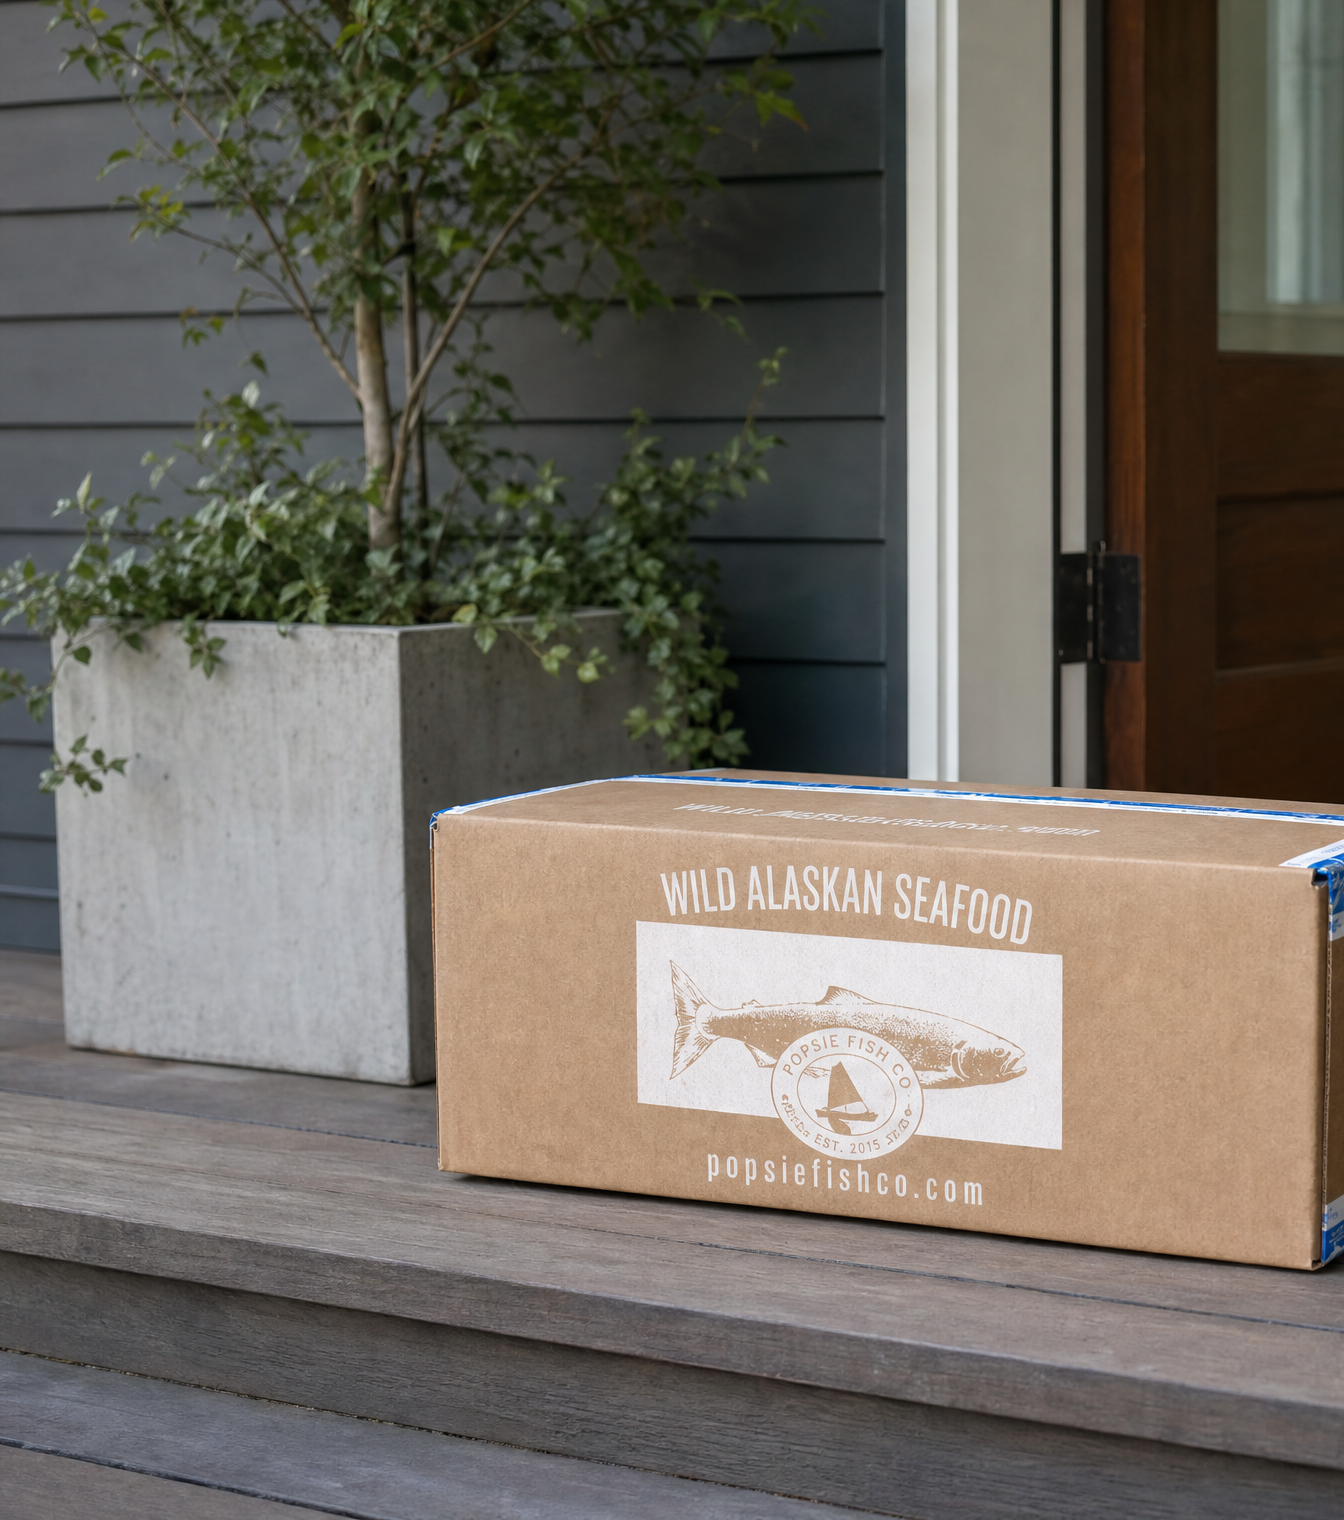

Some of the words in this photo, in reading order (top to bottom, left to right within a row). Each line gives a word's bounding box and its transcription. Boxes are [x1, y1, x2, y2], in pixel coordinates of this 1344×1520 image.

[660, 867, 736, 916] WILD
[748, 865, 882, 916] ALASKAN
[894, 873, 1033, 945] SEAFOOD
[782, 1034, 839, 1076] POPSIE
[848, 1035, 890, 1062] FISH
[814, 1134, 843, 1153] EST.
[850, 1139, 881, 1154] 2015
[707, 1153, 983, 1206] popsiefishco.com
